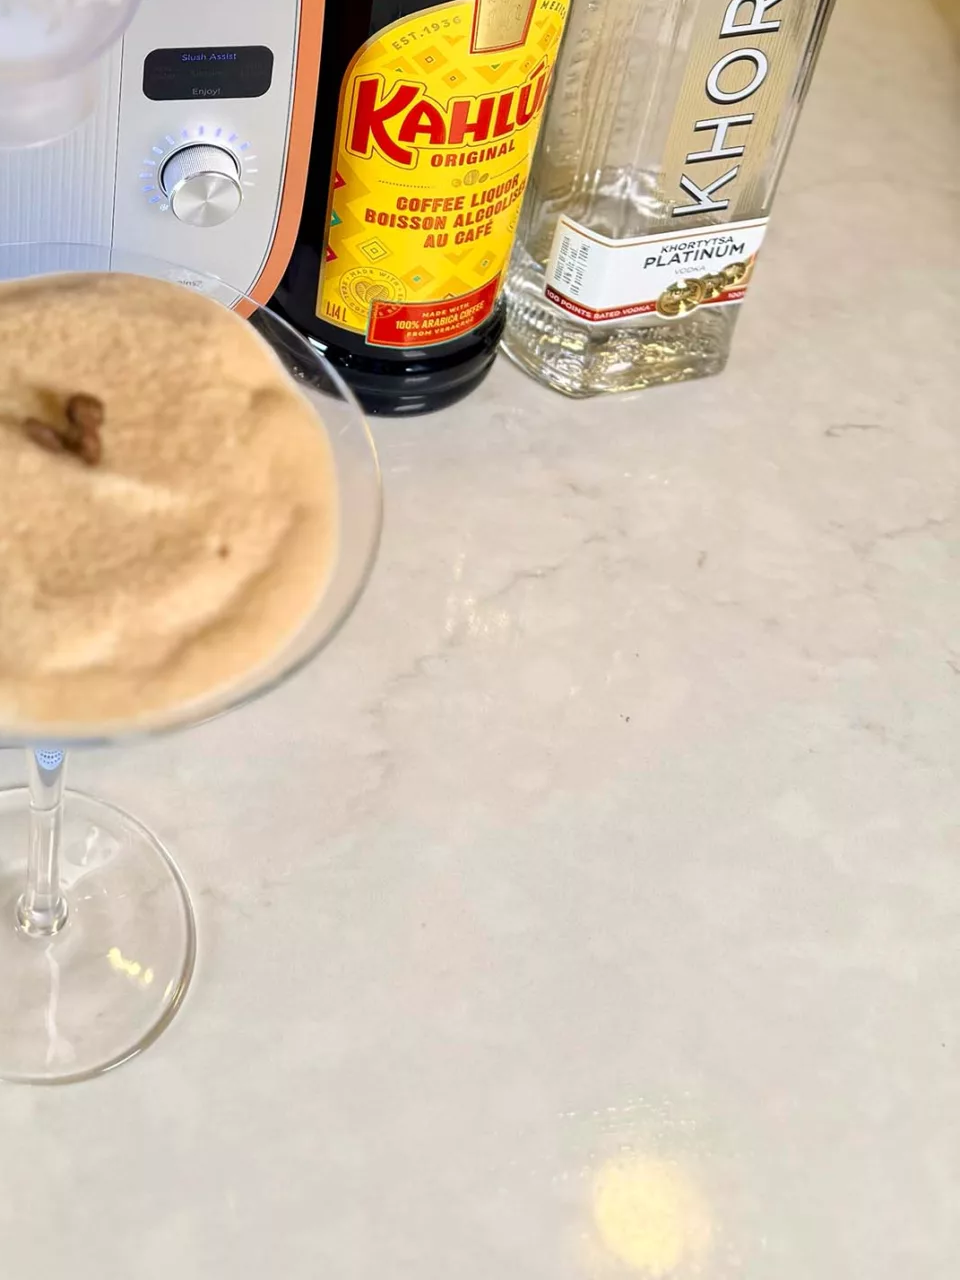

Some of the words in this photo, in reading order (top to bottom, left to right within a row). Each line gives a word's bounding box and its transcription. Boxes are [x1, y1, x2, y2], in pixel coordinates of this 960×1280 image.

[181, 53, 207, 62] Slush
[209, 53, 237, 61] Assist
[192, 88, 221, 97] Enjoy!
[430, 138, 516, 168] ORIGINAL
[396, 195, 465, 213] COFFEE
[469, 172, 521, 209] LIQUOR
[364, 207, 448, 231] BOISSON
[423, 233, 448, 249] AU
[454, 219, 494, 246] CAFÉ
[660, 235, 735, 254] KHORTYTSA
[642, 242, 746, 269] PLATINUM
[395, 320, 420, 330] 100%
[421, 313, 459, 329] ARABICA
[459, 300, 485, 320] COFFEE
[421, 309, 447, 318] MADE
[449, 302, 470, 314] WITH
[560, 299, 592, 318] POINTS
[593, 310, 621, 320] RATED
[406, 330, 432, 338] FROM
[434, 316, 475, 334] VERACRUZ
